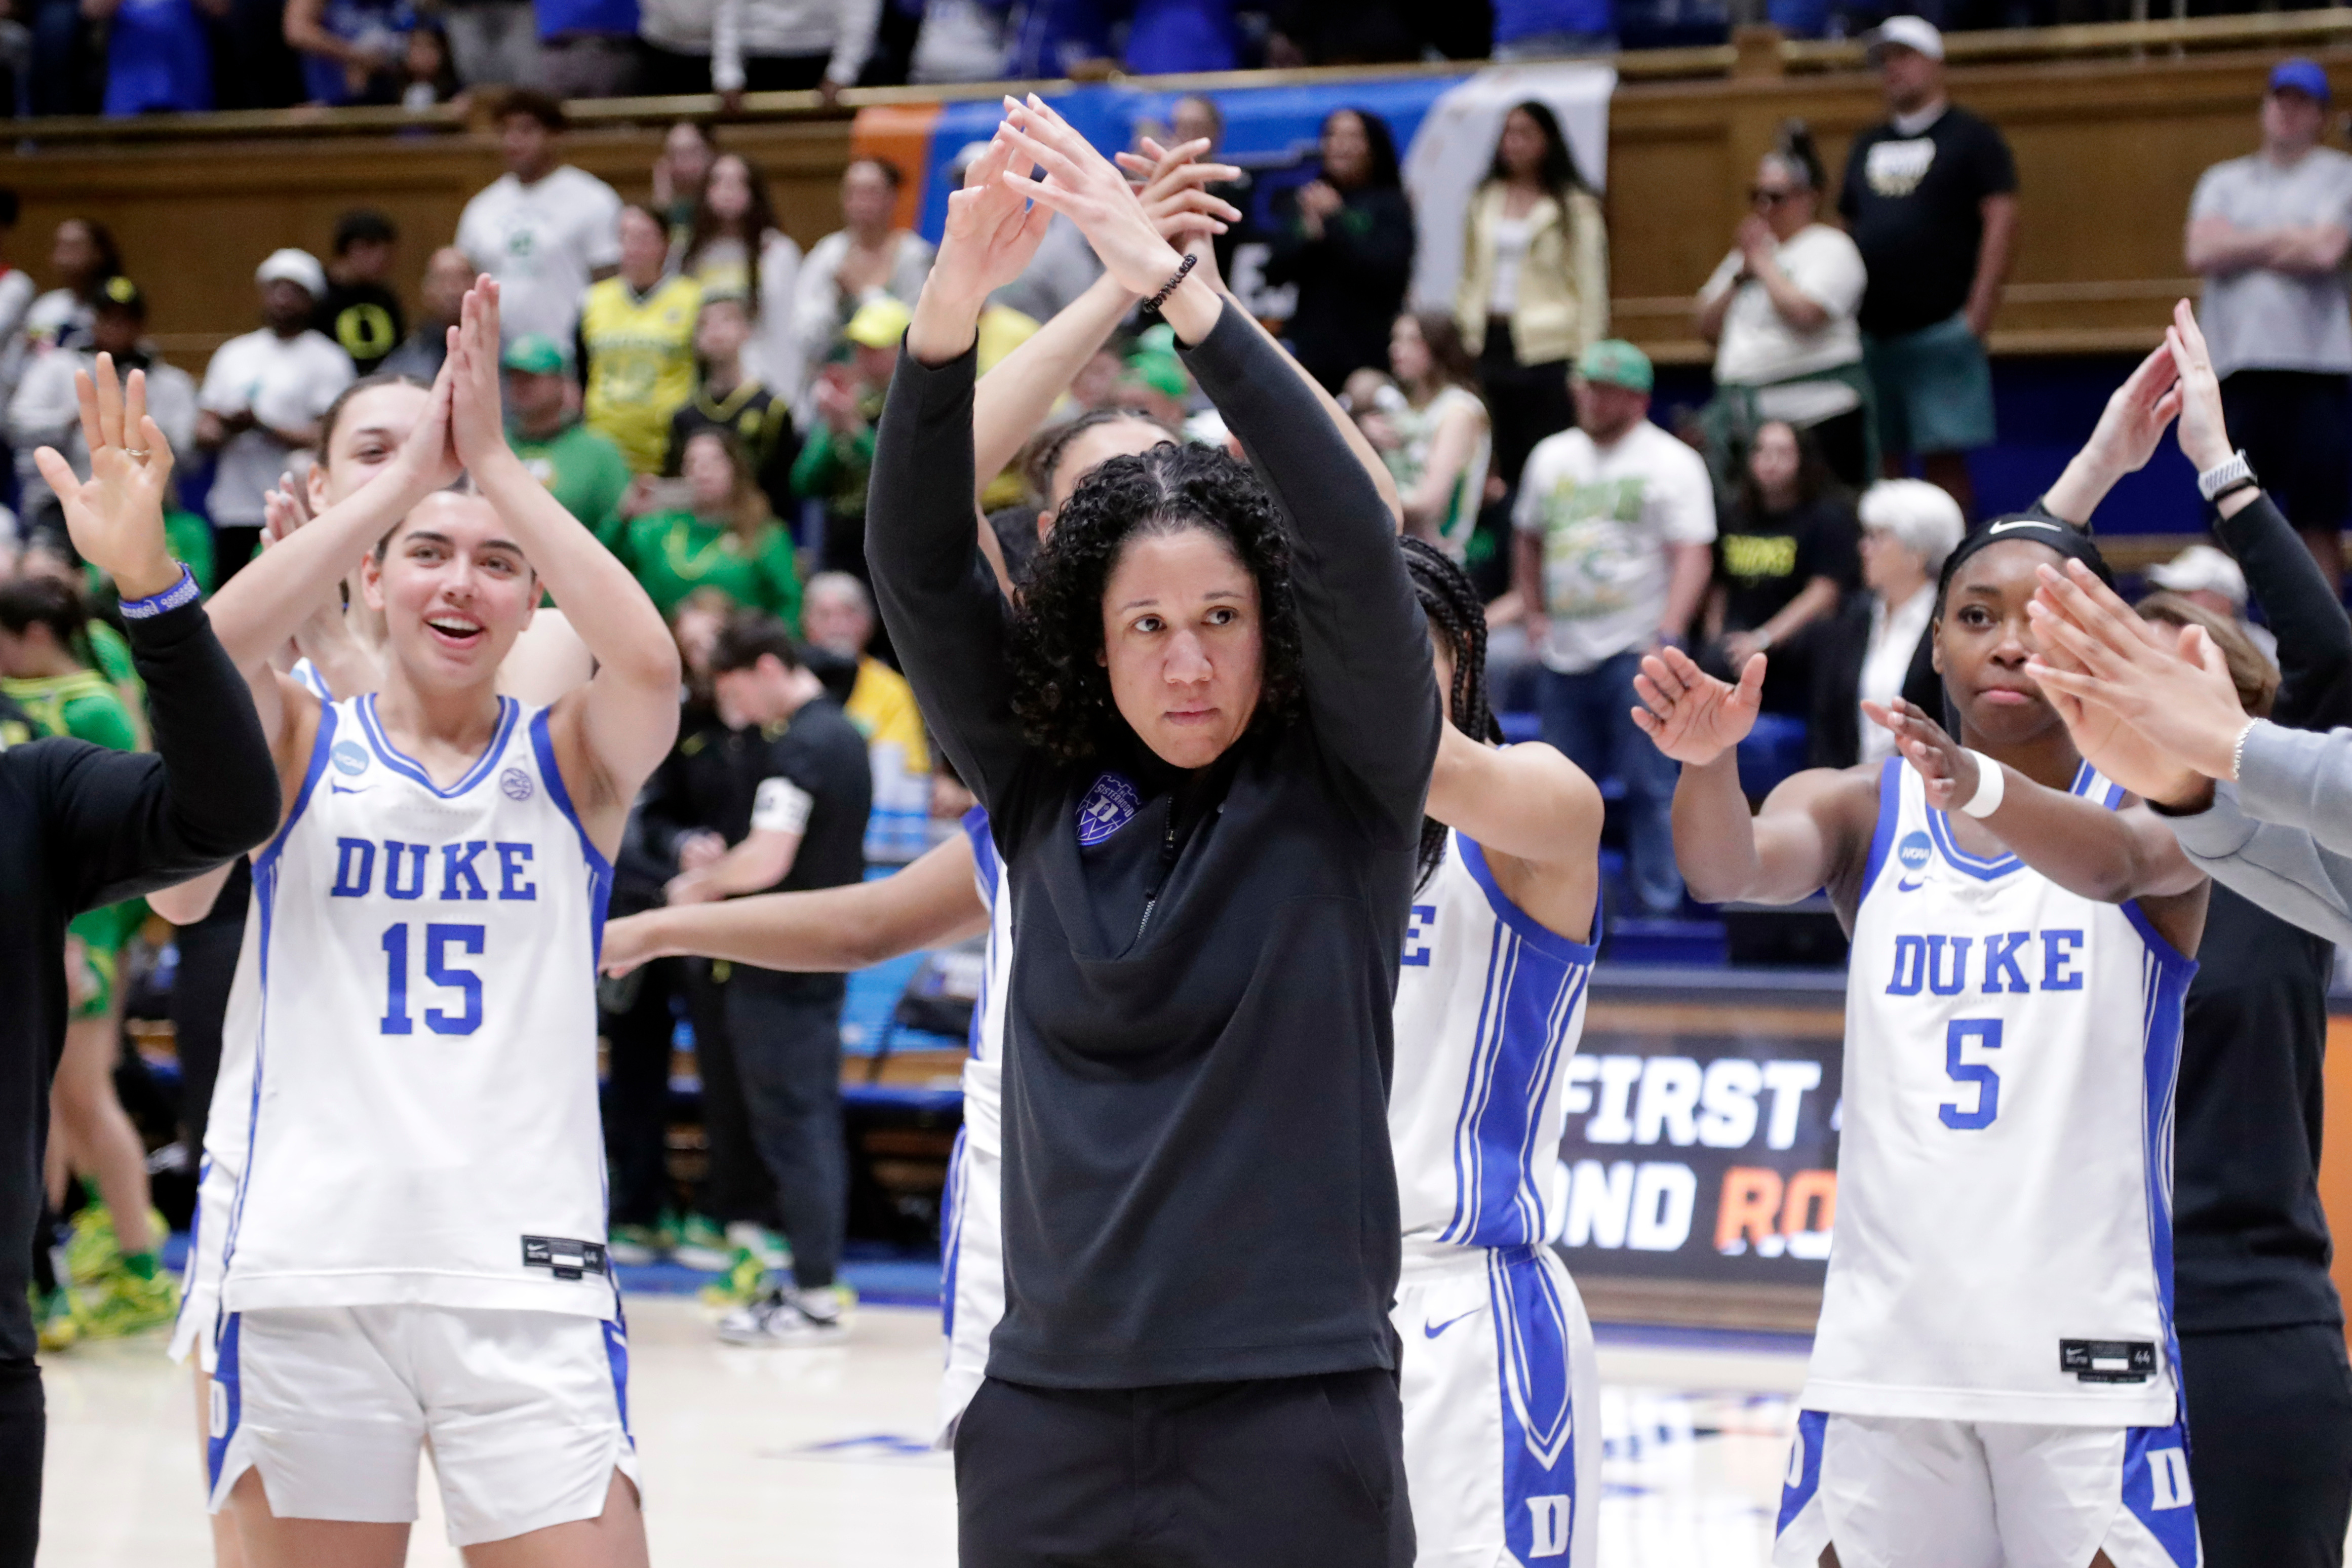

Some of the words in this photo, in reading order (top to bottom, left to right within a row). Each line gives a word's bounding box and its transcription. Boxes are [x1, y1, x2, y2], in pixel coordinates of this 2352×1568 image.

[1094, 783, 1134, 817] SISTERHOOD
[330, 837, 536, 900] DUKE
[380, 922, 486, 1035] 15
[1885, 929, 2084, 996] DUKE
[1559, 1053, 1822, 1150] FIRST
[1938, 1018, 2004, 1130] 5
[2134, 1350, 2150, 1364] 44
